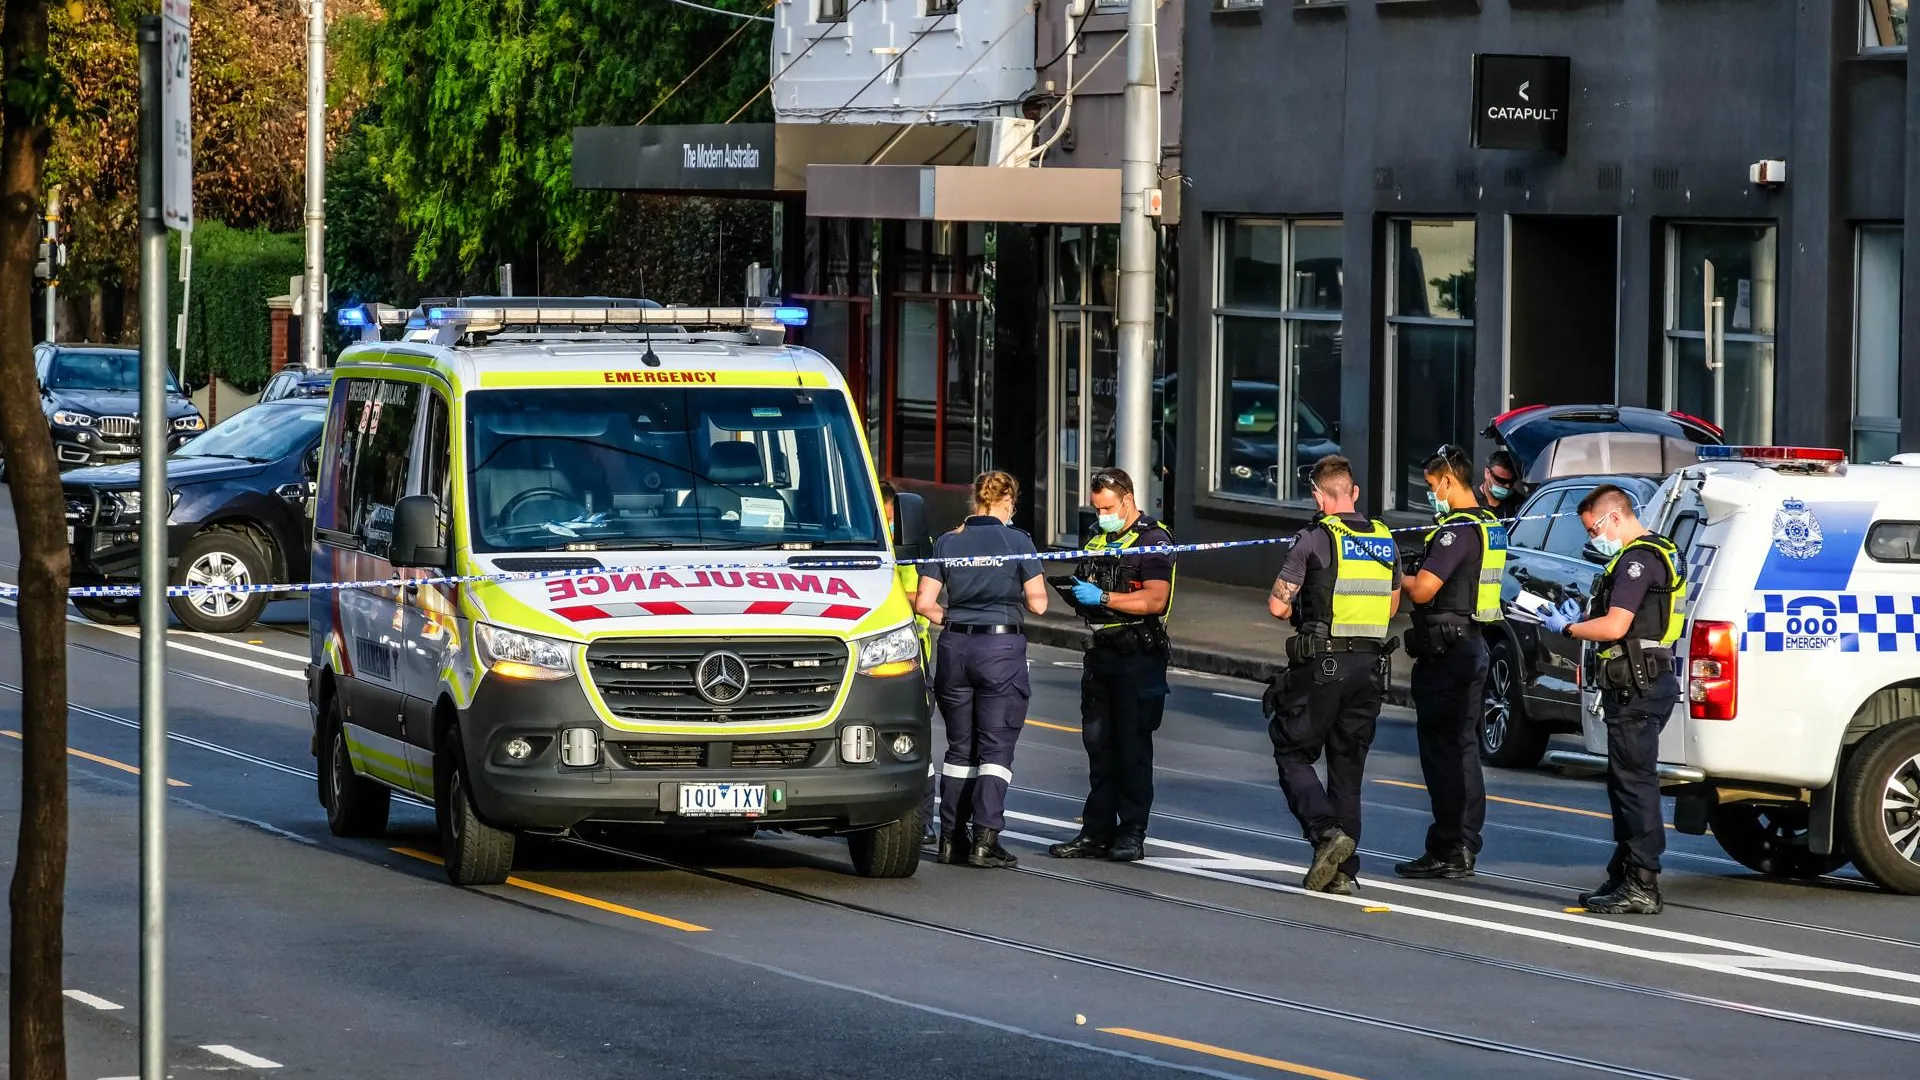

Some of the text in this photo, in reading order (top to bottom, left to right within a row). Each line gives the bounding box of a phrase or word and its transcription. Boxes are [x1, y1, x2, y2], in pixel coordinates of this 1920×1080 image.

[1488, 106, 1559, 120] CATAPULT
[683, 143, 759, 168] The Modern Australian
[603, 371, 718, 383] EMERGENCY
[1344, 540, 1392, 558] Police
[944, 556, 1004, 567] PARAMEDIC
[685, 788, 764, 808] 1QU 1XV
